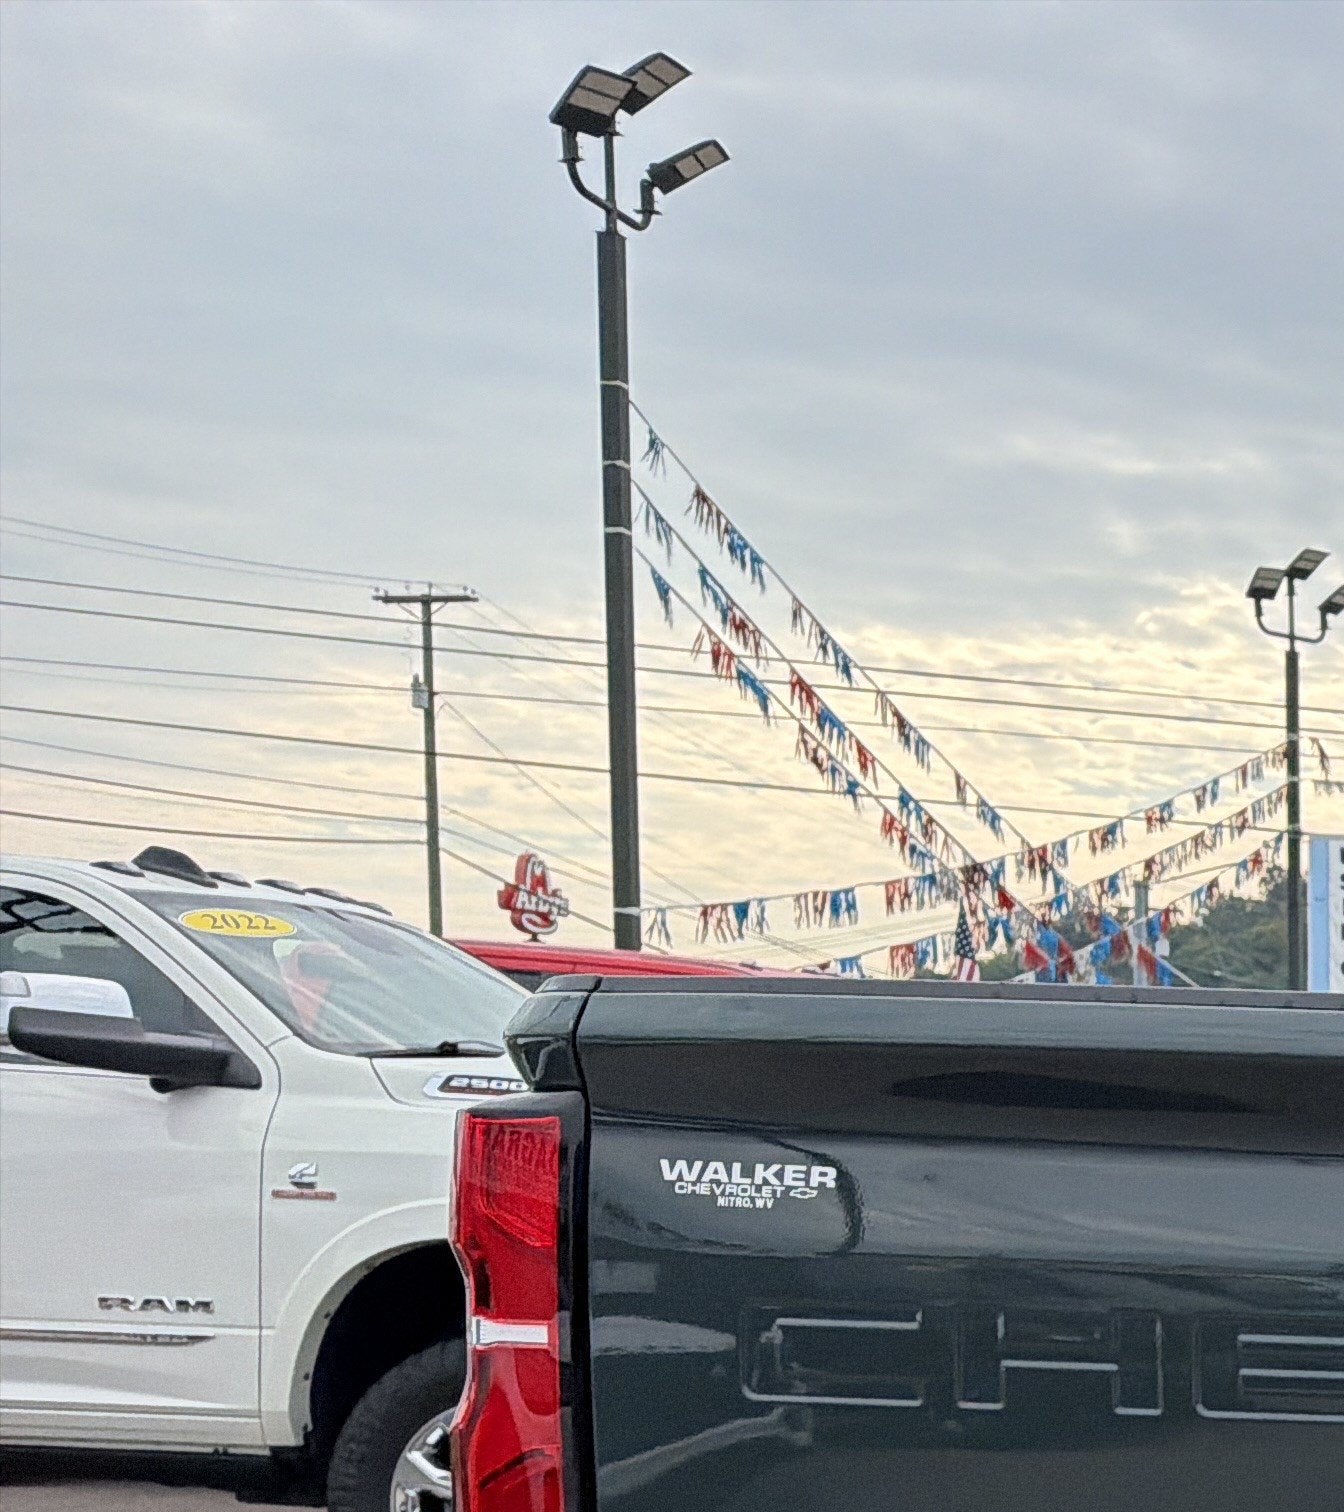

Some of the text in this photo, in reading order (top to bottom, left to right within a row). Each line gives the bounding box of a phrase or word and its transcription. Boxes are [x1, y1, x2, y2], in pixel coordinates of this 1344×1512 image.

[201, 913, 276, 931] 2022
[448, 1077, 530, 1091] 2500
[659, 1158, 838, 1189] WALKER
[674, 1181, 785, 1199] CHEVROLET
[716, 1195, 774, 1210] NITRO, WV
[97, 1293, 215, 1314] RAM
